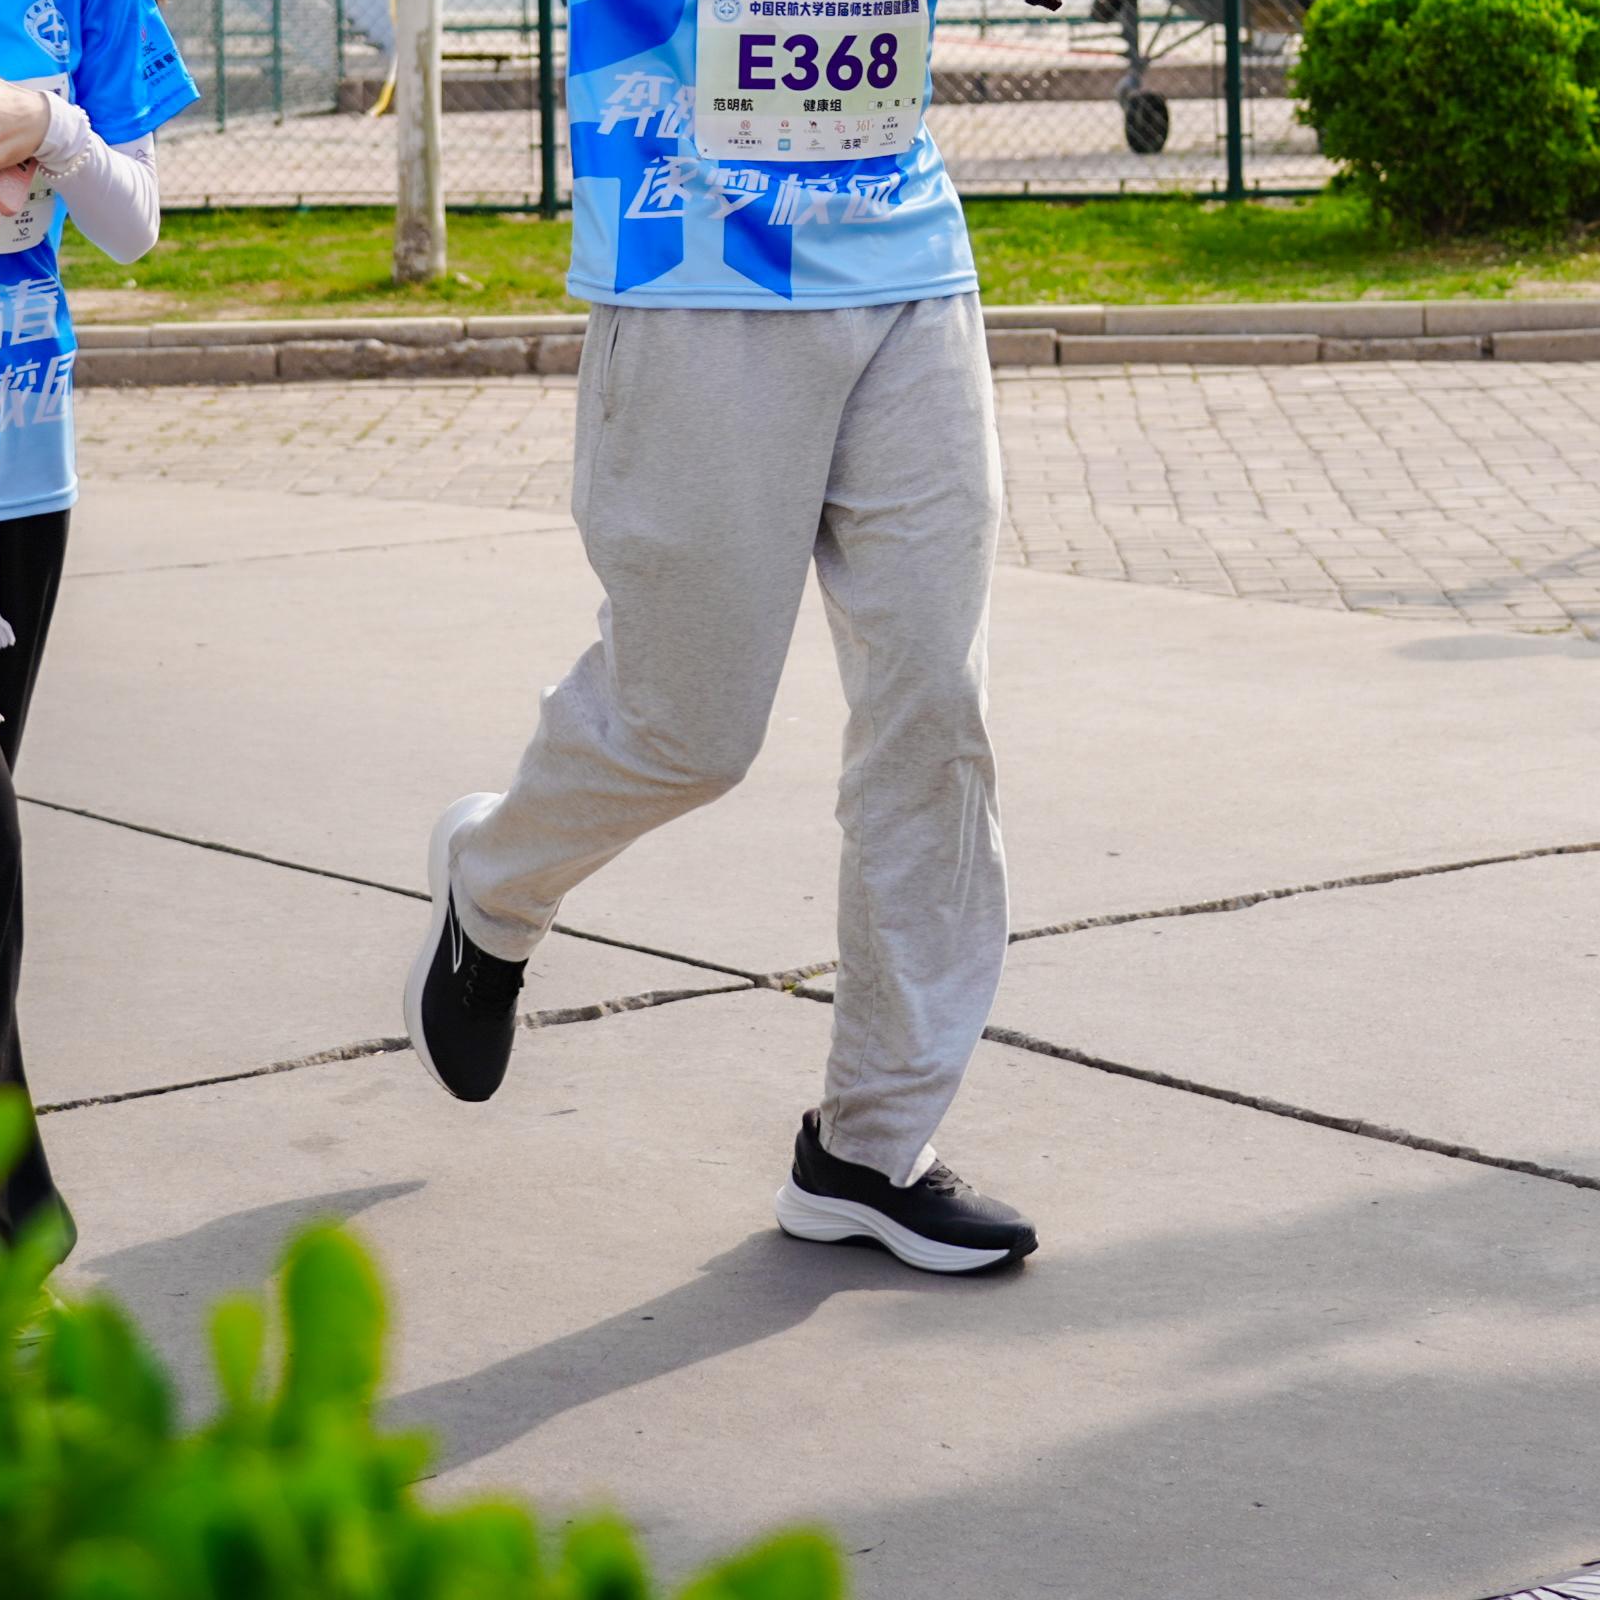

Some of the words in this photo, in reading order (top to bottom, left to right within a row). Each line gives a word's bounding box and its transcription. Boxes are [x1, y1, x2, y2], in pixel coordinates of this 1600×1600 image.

[737, 32, 898, 91] E368
[713, 97, 755, 113] 范明航
[803, 98, 843, 113] 健康组
[623, 154, 901, 226] 逐梦校园
